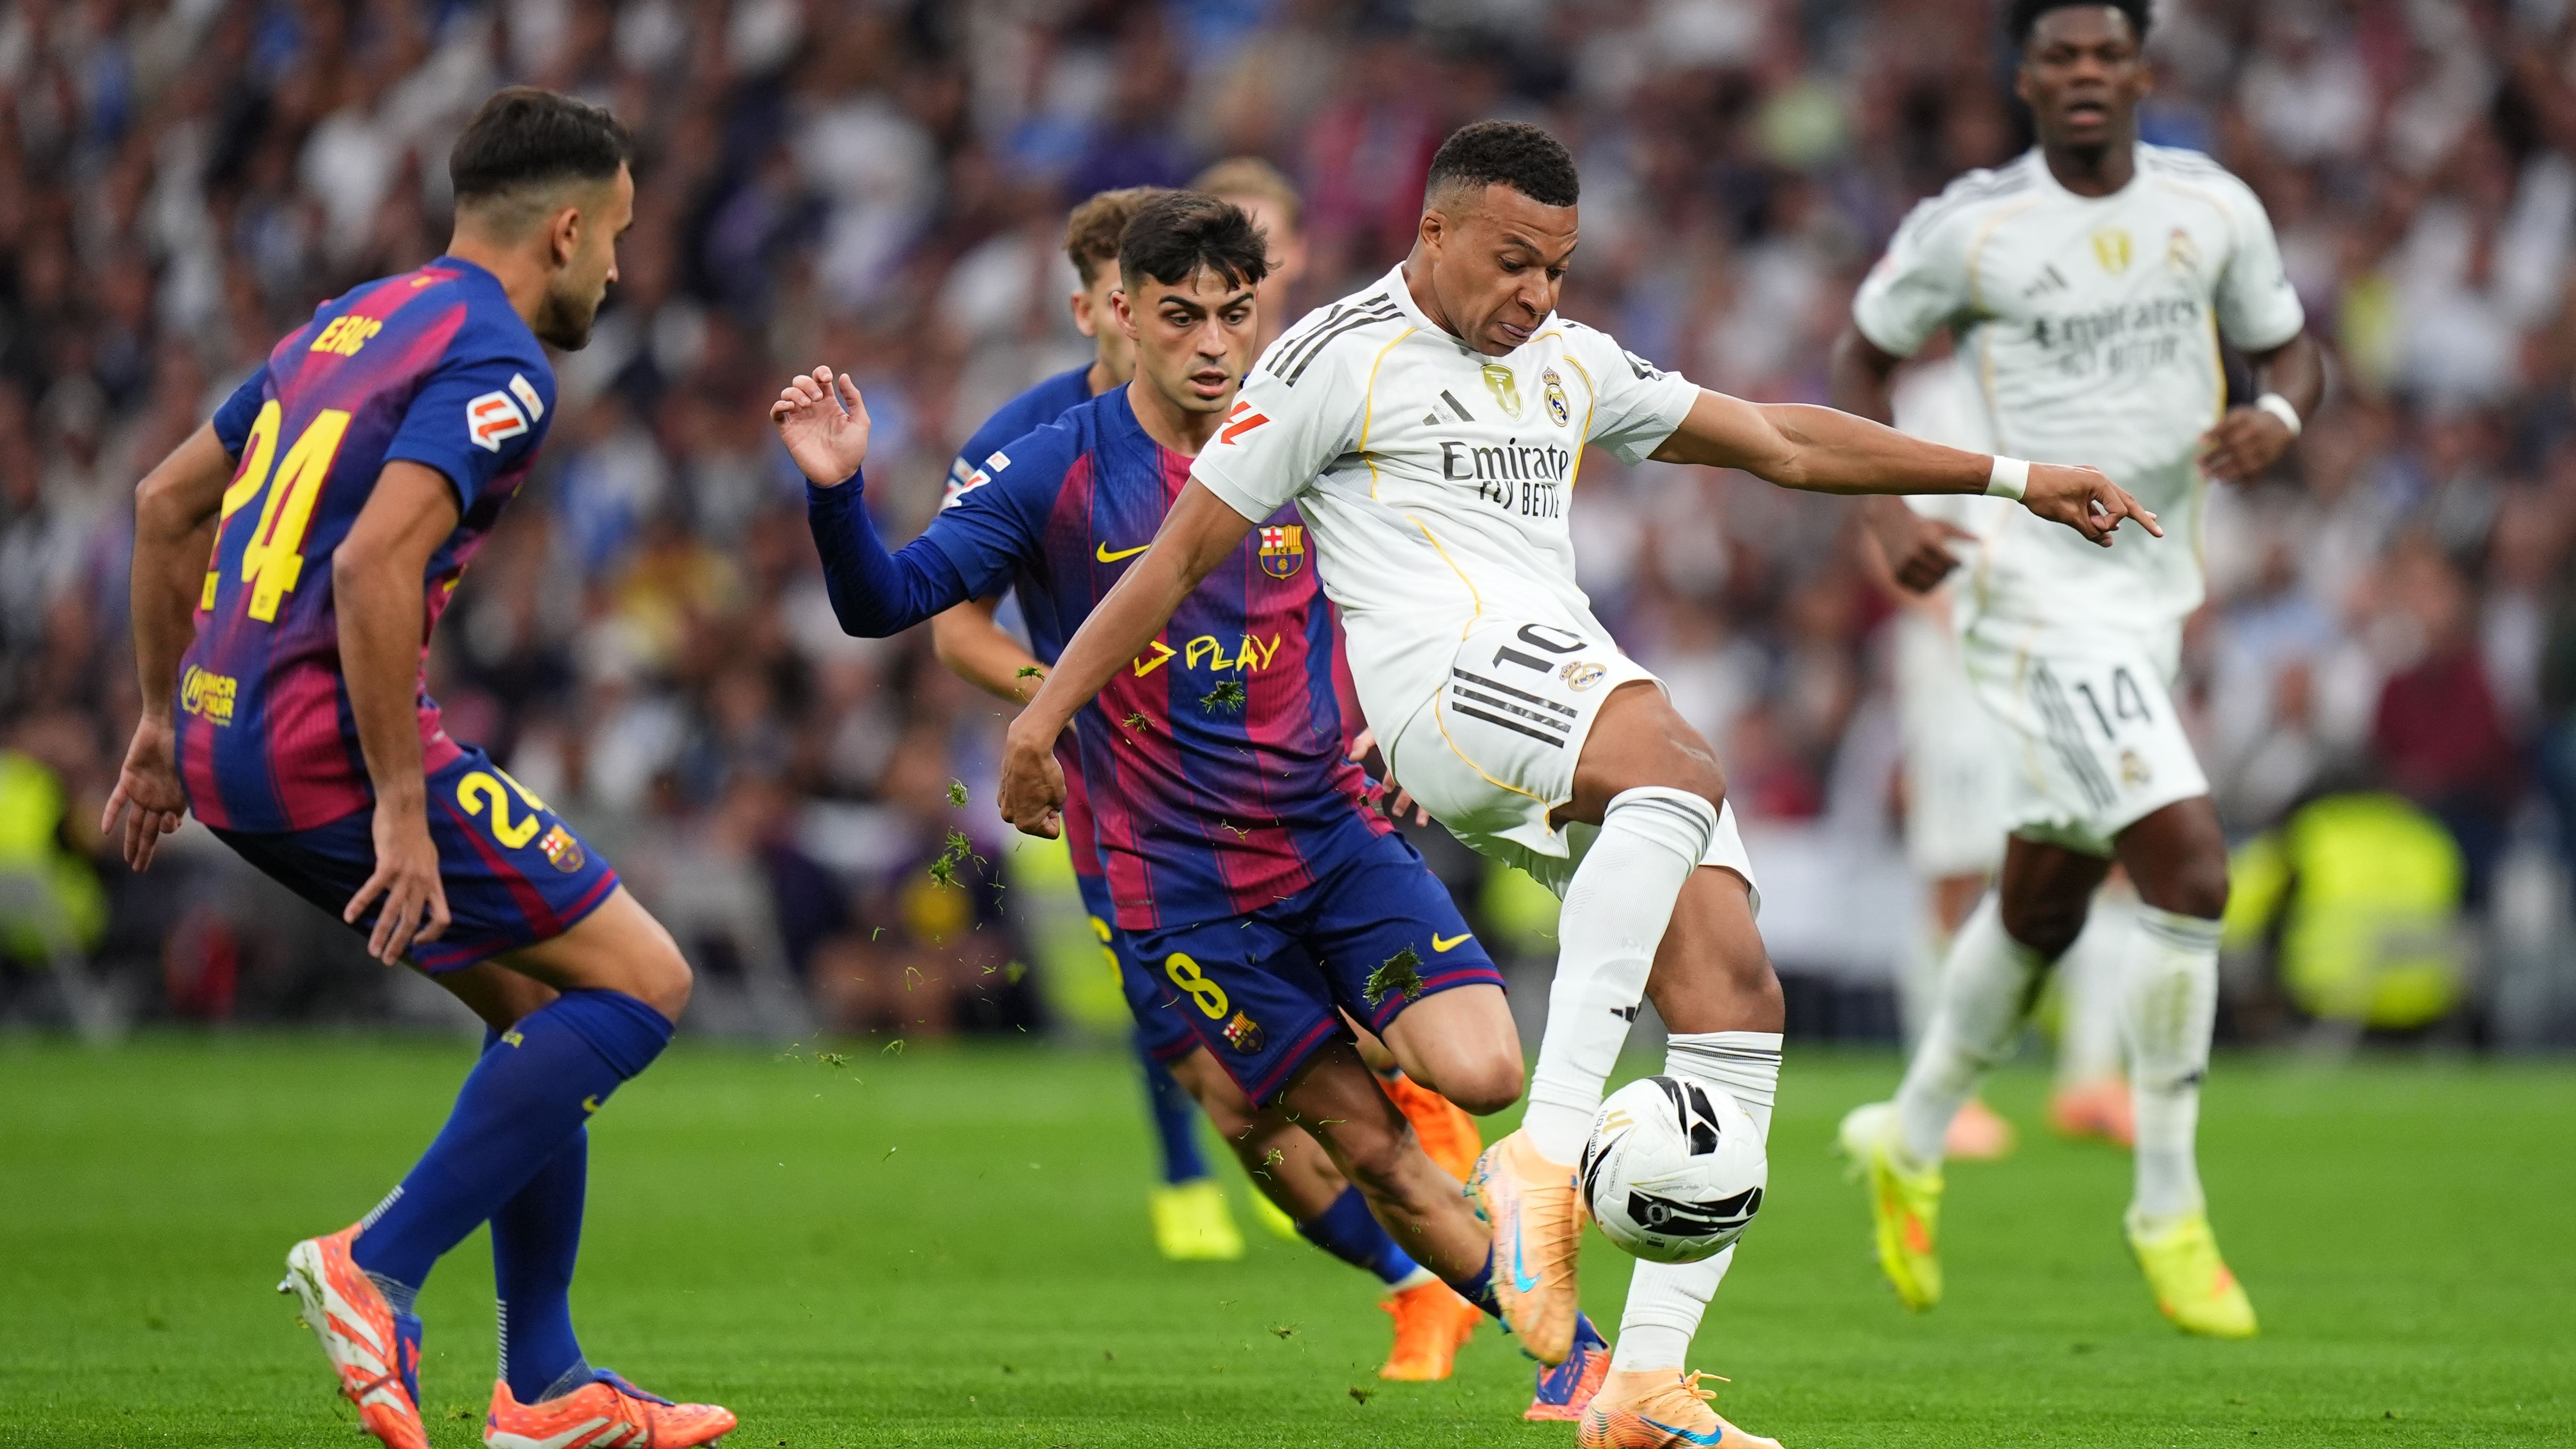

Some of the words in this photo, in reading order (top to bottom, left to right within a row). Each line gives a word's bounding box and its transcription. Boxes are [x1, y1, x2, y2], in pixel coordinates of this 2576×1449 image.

[310, 315, 383, 357] ERIC
[1439, 437, 1568, 481] Emirate
[200, 398, 351, 623] 24
[1186, 632, 1281, 672] PLAY
[1492, 623, 1590, 673] 10
[2076, 664, 2154, 742] 14
[1165, 952, 1229, 1019] 8
